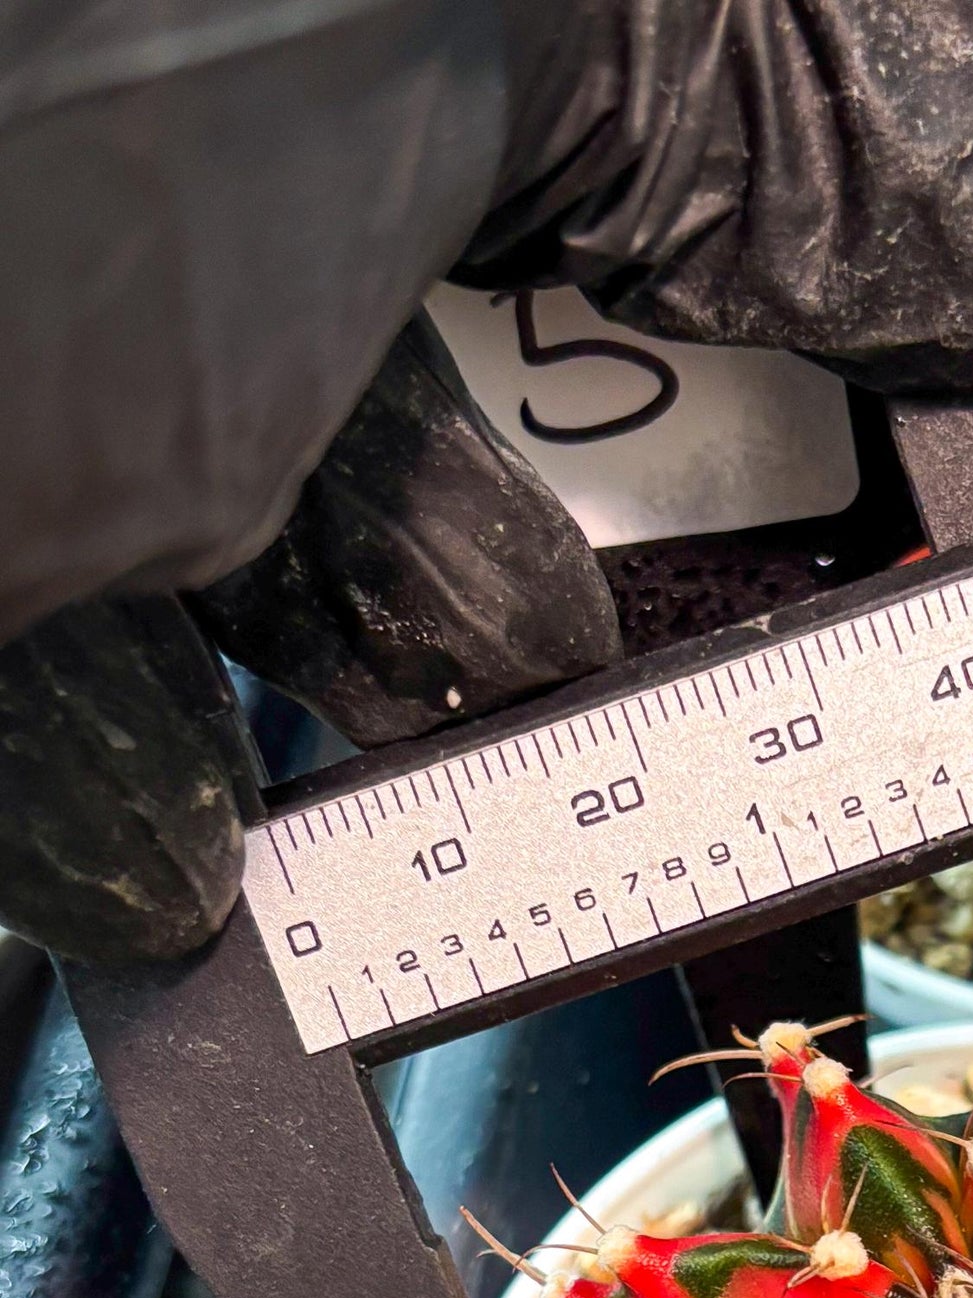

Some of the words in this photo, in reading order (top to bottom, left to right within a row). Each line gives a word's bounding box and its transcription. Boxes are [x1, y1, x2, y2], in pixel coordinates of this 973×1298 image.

[490, 289, 679, 445] 5
[284, 919, 322, 957] 0
[411, 837, 467, 882] 10
[570, 775, 646, 827] 20
[748, 713, 823, 765] 30
[361, 964, 375, 985] 1
[395, 949, 421, 973] 2
[440, 933, 465, 956] 3
[487, 919, 508, 942] 4
[529, 904, 552, 927] 5
[573, 887, 597, 911] 6
[621, 872, 640, 895] 7
[662, 857, 688, 881] 8
[707, 842, 732, 866] 9
[745, 802, 767, 835] 1
[806, 810, 820, 832] 1
[840, 795, 866, 820] 2
[885, 779, 909, 802] 3
[931, 764, 952, 788] 4
